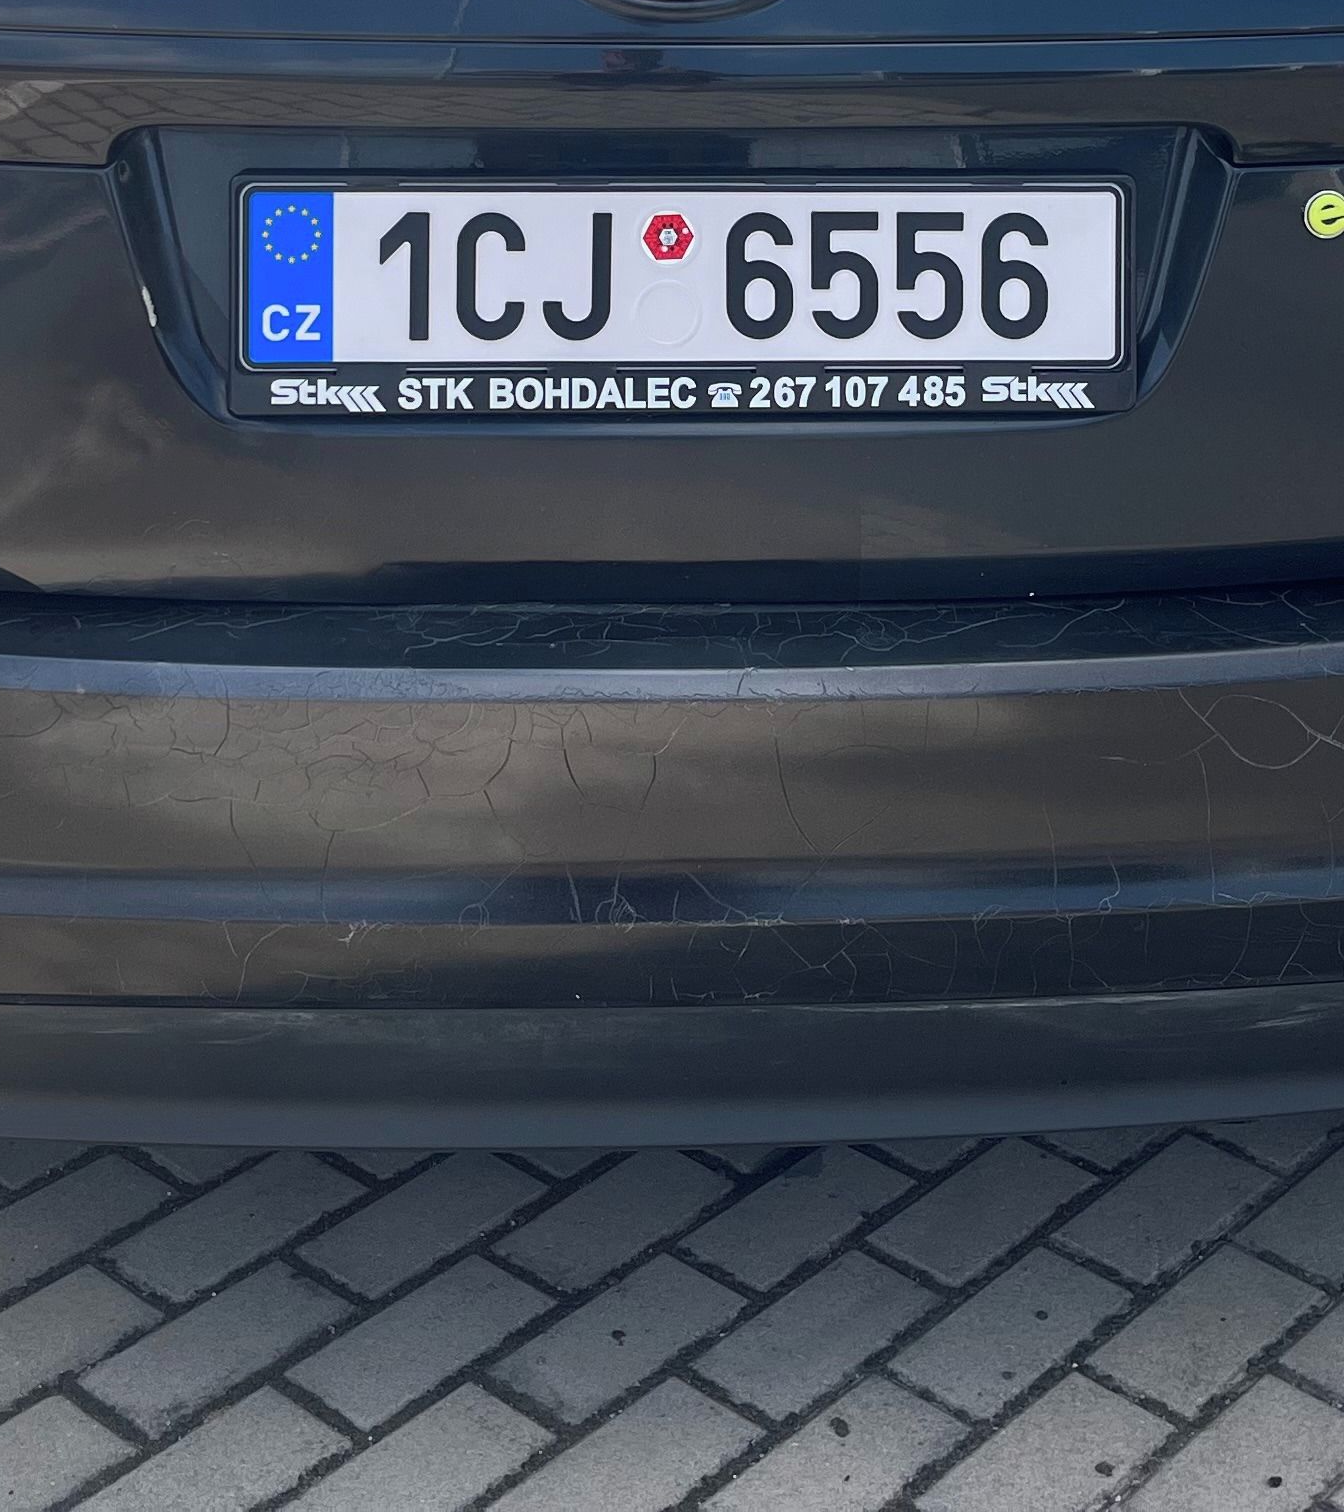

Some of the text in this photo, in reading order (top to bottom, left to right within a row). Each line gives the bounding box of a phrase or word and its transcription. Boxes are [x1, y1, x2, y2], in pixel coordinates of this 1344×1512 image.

[379, 211, 1050, 342] 1CJ 6556
[261, 303, 322, 343] CZ
[397, 377, 475, 410] STK
[489, 377, 697, 410] BOHDALEC
[749, 376, 817, 408] 267
[824, 376, 890, 408] 107
[897, 375, 967, 408] 485
